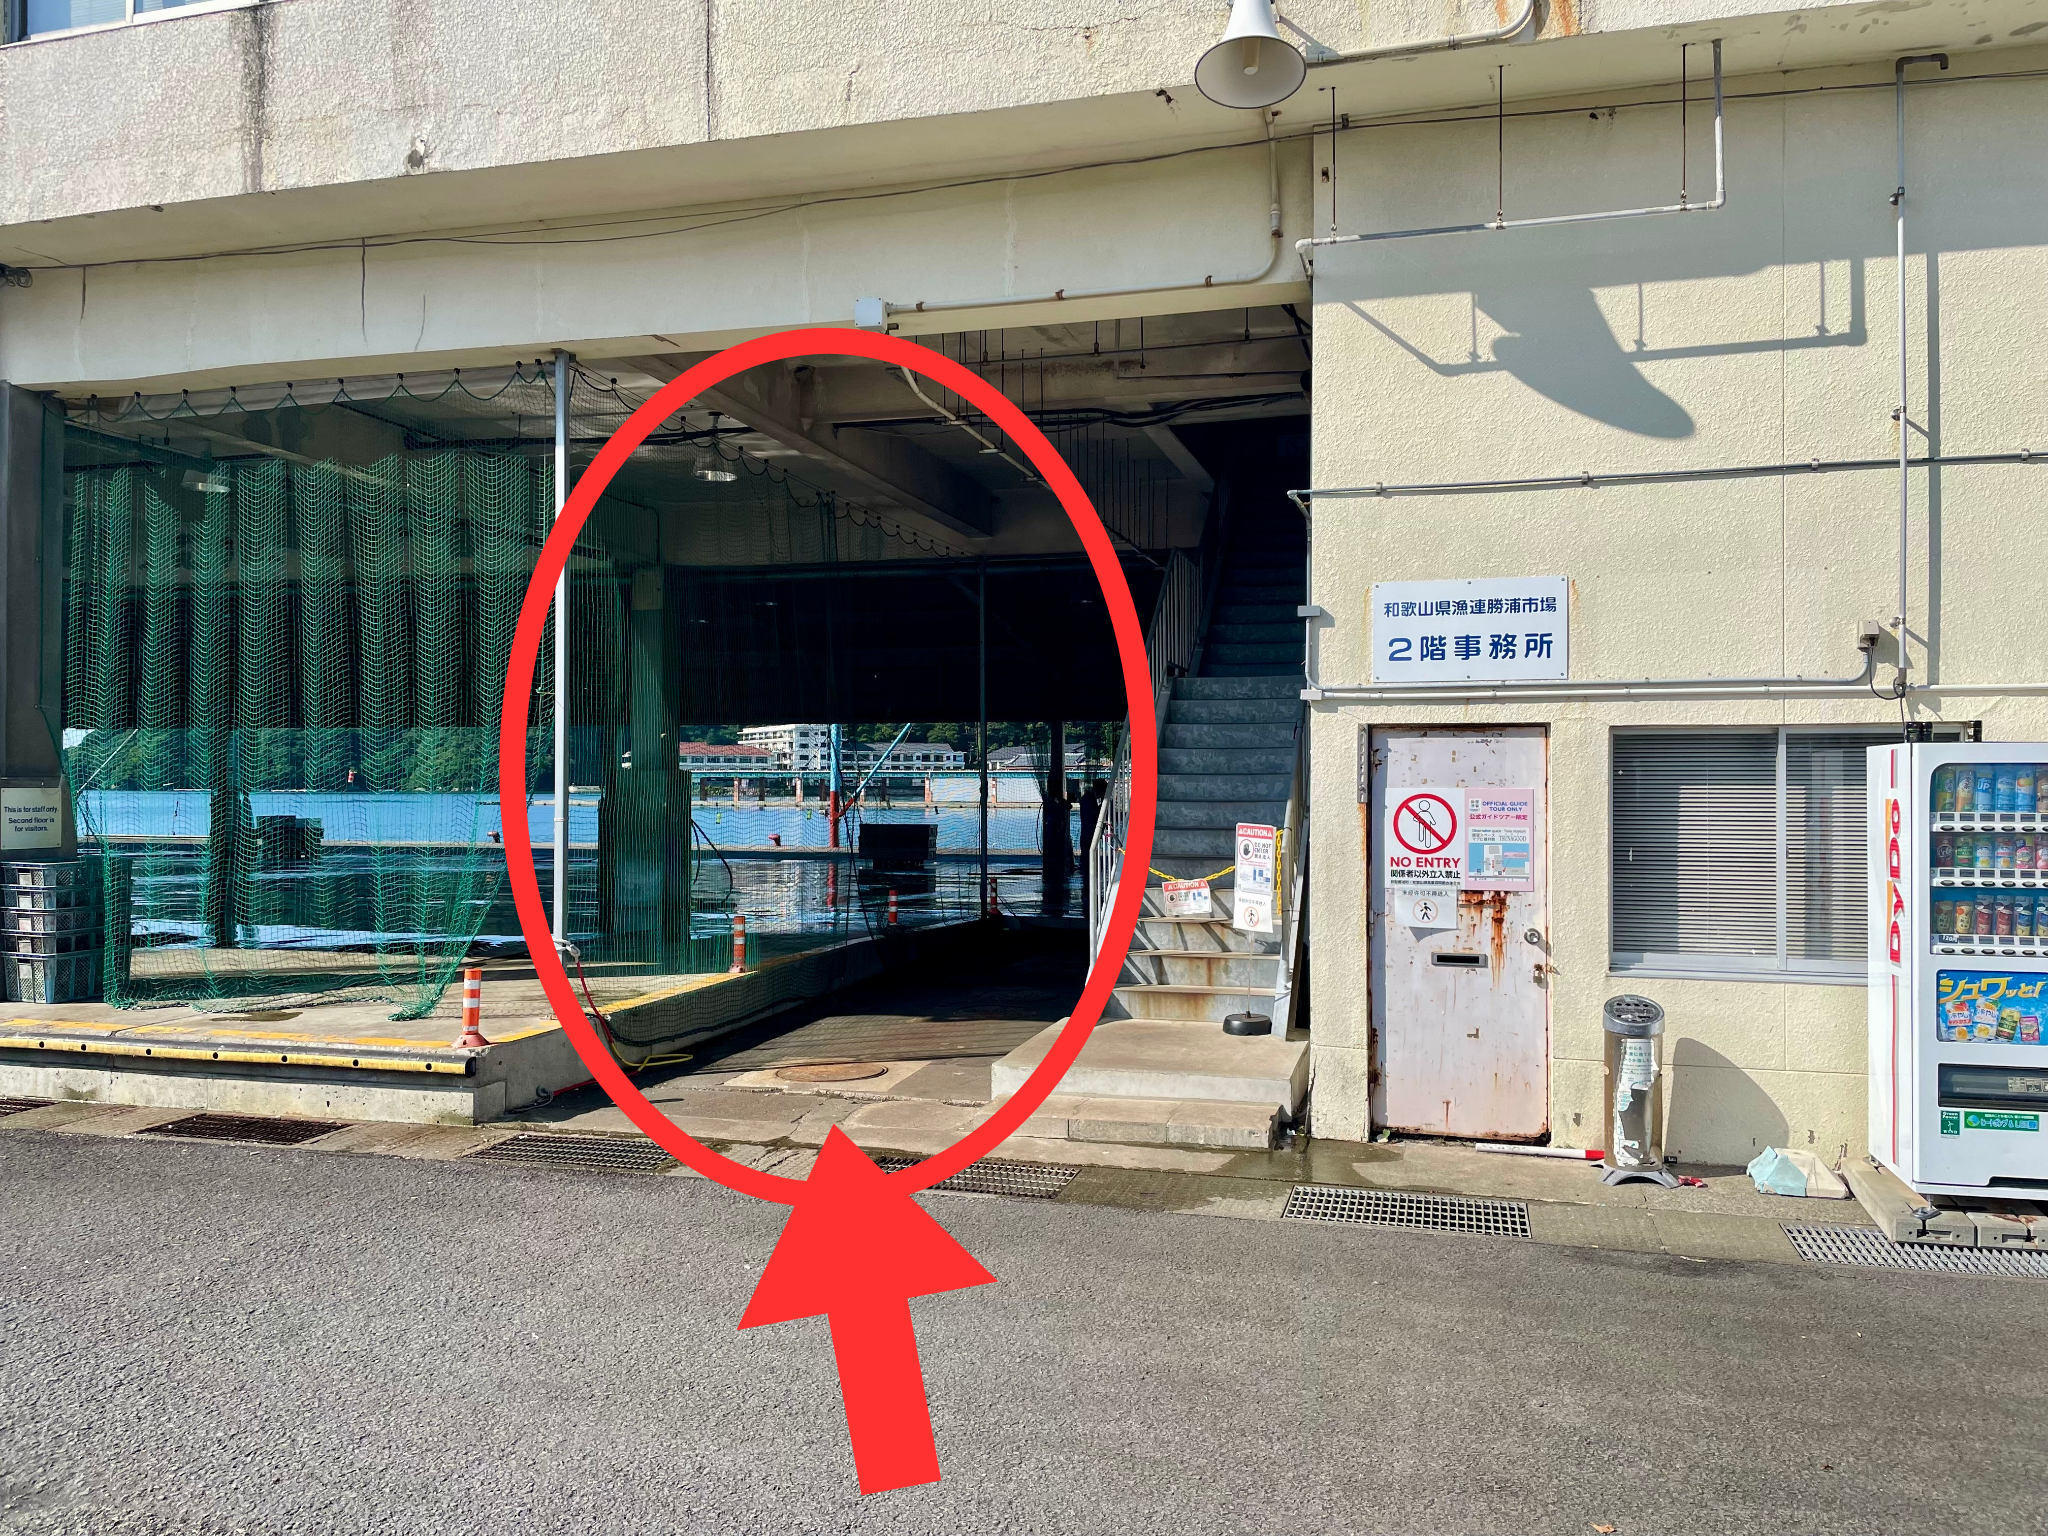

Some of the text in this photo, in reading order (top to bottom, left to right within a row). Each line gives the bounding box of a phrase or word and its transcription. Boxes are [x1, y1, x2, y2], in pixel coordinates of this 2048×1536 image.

[1383, 596, 1558, 618] 和歌山県漁連勝浦市場
[31, 805, 45, 813] staff
[34, 816, 48, 824] floor
[1242, 828, 1269, 837] CAUTION
[1390, 856, 1461, 869] NO ENTRY
[1390, 869, 1461, 879] 関係者以外立入禁止
